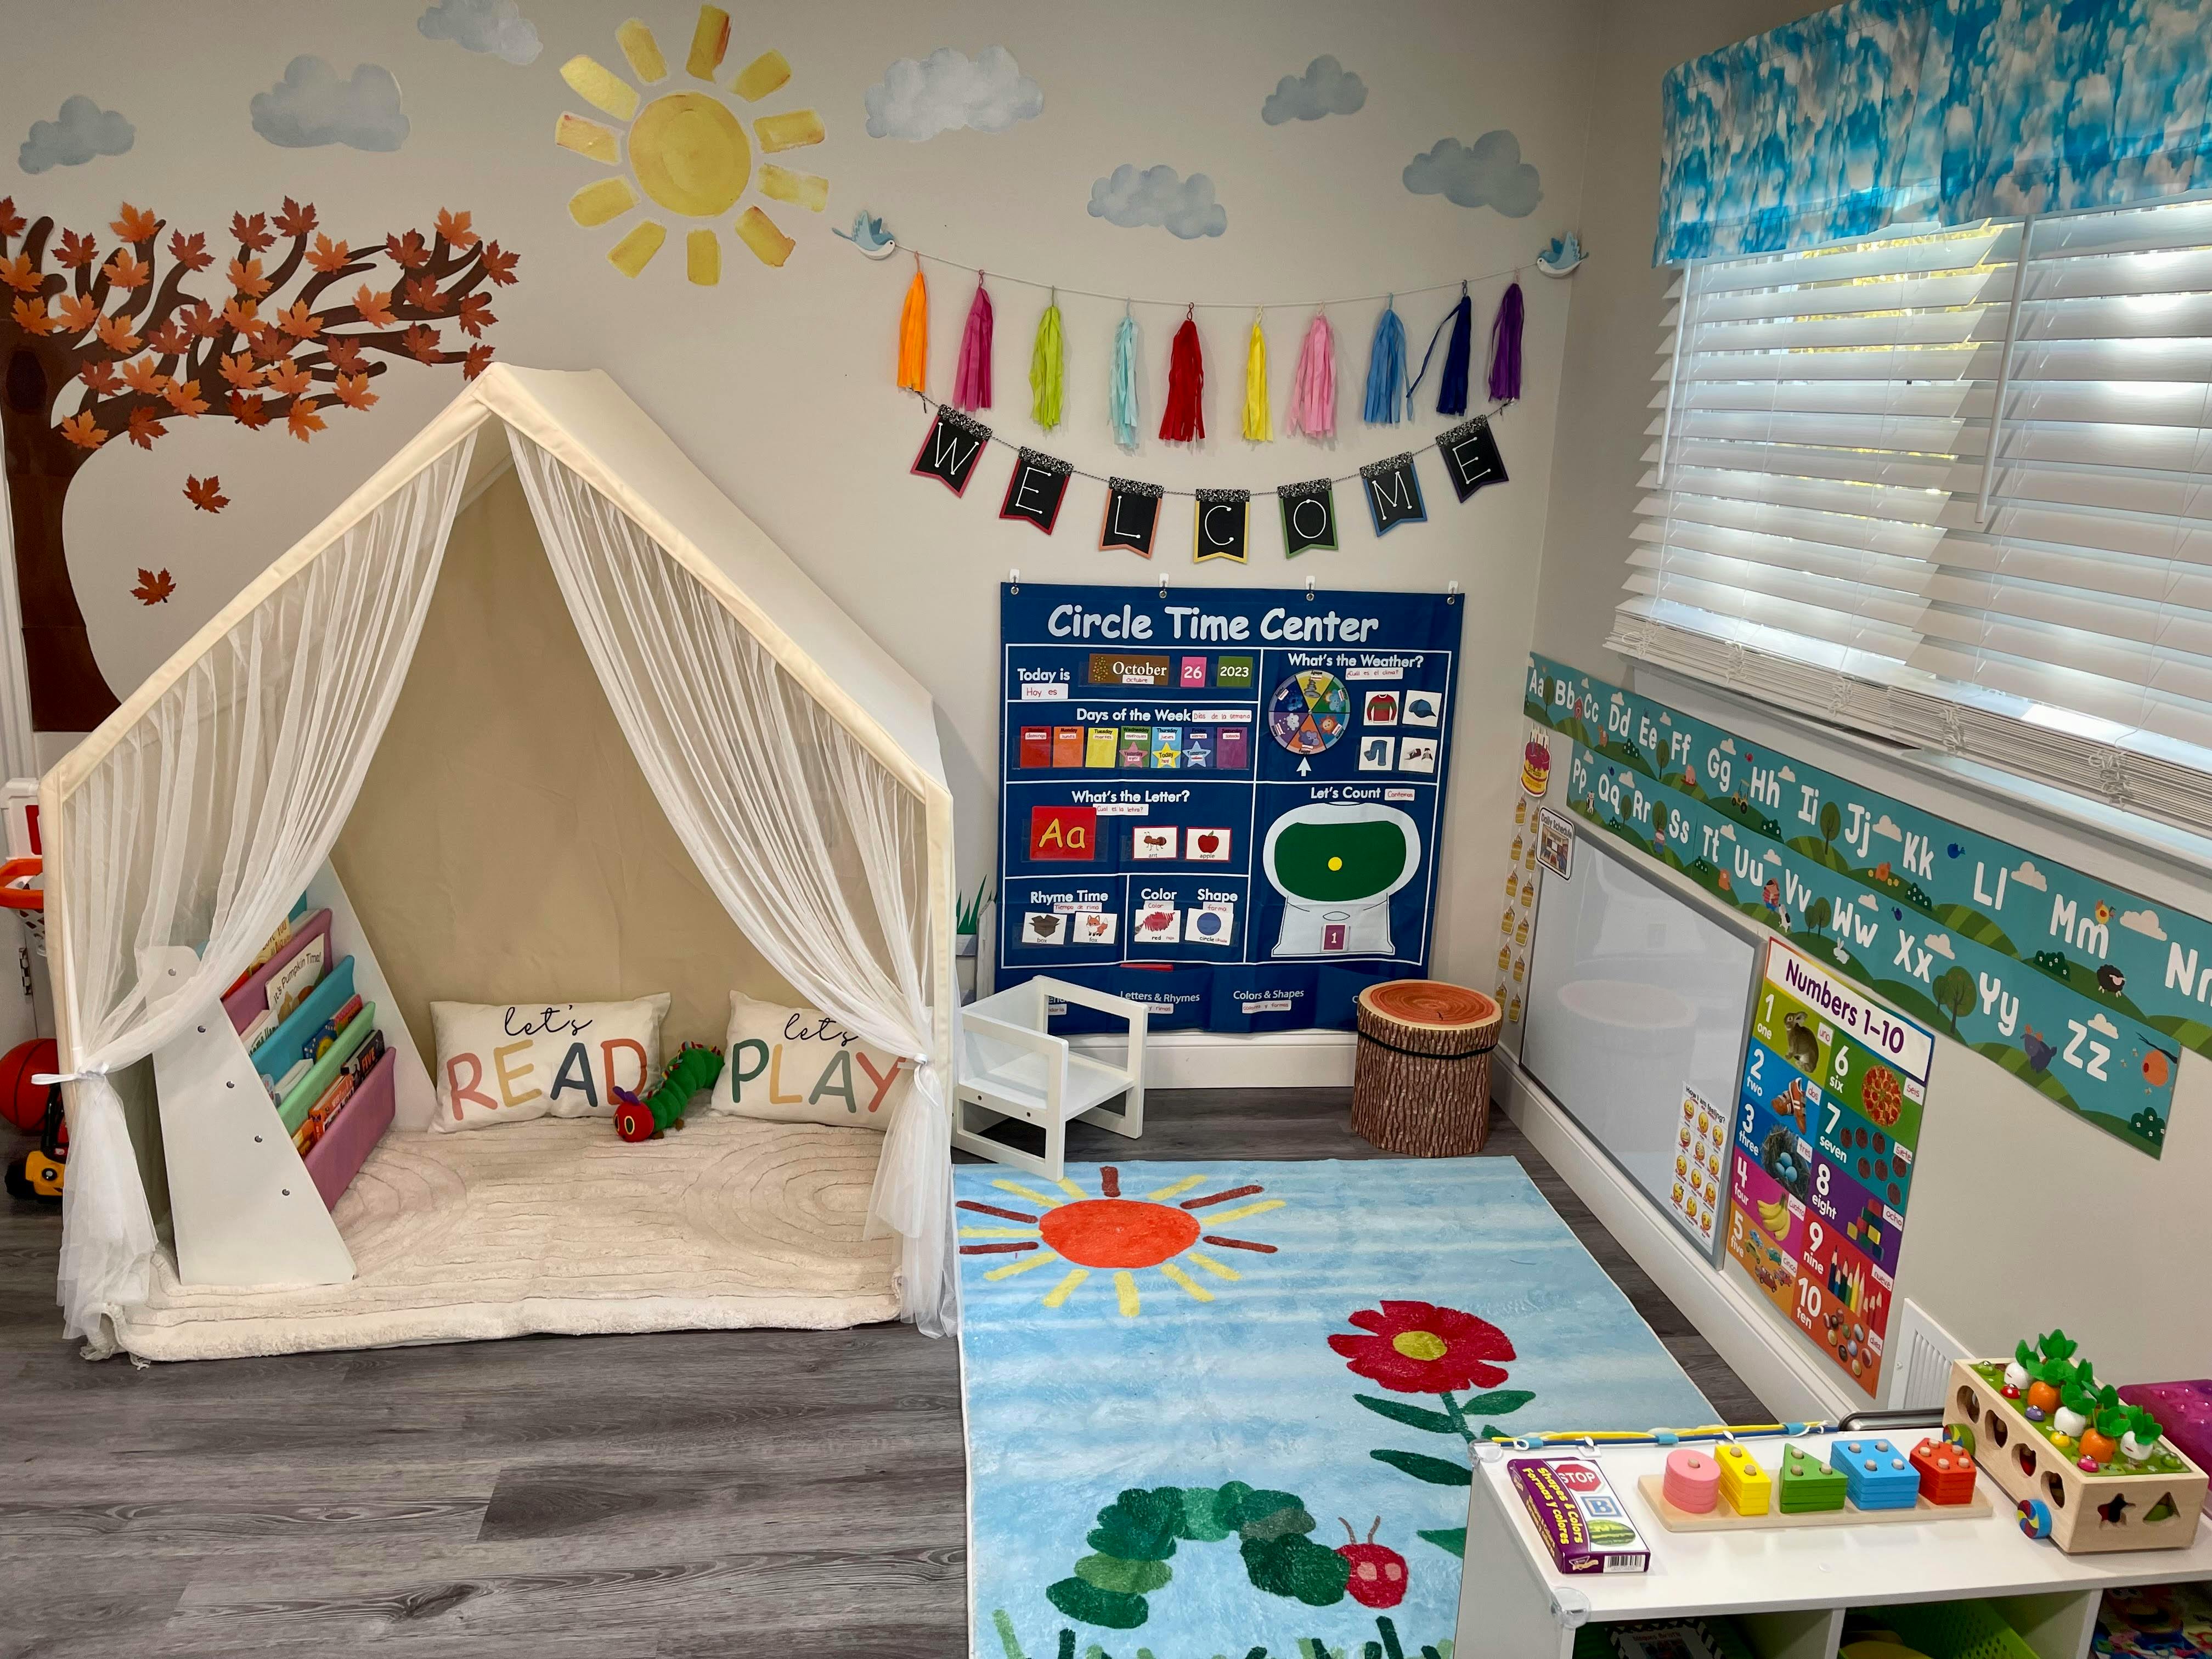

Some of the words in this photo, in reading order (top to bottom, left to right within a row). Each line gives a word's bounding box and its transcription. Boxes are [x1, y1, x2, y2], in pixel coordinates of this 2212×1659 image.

[931, 421, 1492, 546] WELCOME
[1048, 605, 1153, 639] Circle
[1164, 606, 1250, 641] Time
[1260, 607, 1379, 642] Center
[1113, 662, 1167, 676] October
[1220, 666, 1249, 677] 2023
[1288, 653, 1333, 666] What's
[1336, 654, 1356, 667] the
[1361, 654, 1424, 668] Weather?
[1017, 668, 1057, 684] Today
[1060, 669, 1070, 680] is
[1183, 666, 1202, 679] 26
[1026, 687, 1042, 698] Hoy
[1077, 708, 1108, 723] Days
[1113, 708, 1127, 721] of
[1130, 708, 1150, 721] the
[1155, 709, 1190, 722] Week
[1071, 790, 1117, 803] What's
[1120, 790, 1141, 802] the
[1145, 790, 1190, 802] Letter?
[1311, 787, 1339, 798] Let's
[1342, 787, 1381, 798] Count
[1529, 669, 1544, 697] Aa
[1554, 679, 1575, 710] Bb
[1584, 693, 1599, 723] Cc
[1608, 704, 1632, 737] Dd
[1639, 716, 1658, 750] Ee
[1671, 731, 1692, 765] Ff
[1707, 747, 1731, 793] Gg
[1750, 766, 1780, 809] Hh
[1798, 785, 1819, 825] Ii
[1844, 803, 1871, 858] Jj
[1903, 832, 1934, 881] Kk
[1973, 861, 2007, 910] Ll
[2050, 894, 2109, 960] Mm
[1541, 813, 1553, 828] Daily
[1553, 820, 1572, 839] Schedule
[1039, 819, 1085, 848] Aa
[1030, 891, 1073, 905] Rhyme
[1077, 890, 1108, 901] Time
[1141, 888, 1177, 900] Color
[1197, 889, 1238, 904] Shape
[1572, 758, 1587, 794] Pp
[1598, 773, 1621, 815] Qq
[1632, 790, 1651, 823] Rr
[1668, 809, 1690, 844] Ss
[1702, 825, 1719, 862] Tt
[1734, 845, 1763, 887] Uu
[1785, 869, 1812, 912] Vv
[1832, 896, 1879, 948] Ww
[1893, 929, 1934, 984] Xx
[1979, 972, 2019, 1036] Yy
[2063, 1019, 2111, 1081] Zz
[1331, 933, 1337, 944] 1
[274, 986, 282, 1004] It's
[281, 959, 306, 989] Pumpkin
[306, 952, 321, 965] Time!
[1120, 991, 1152, 1001] Letters
[1154, 994, 1161, 1002] &
[1164, 994, 1200, 1004] Rhymes
[1233, 990, 1262, 1000] Colors
[1273, 990, 1304, 999] Shapes
[1785, 959, 1857, 1026] Numbers
[1765, 994, 1775, 1023] 1
[504, 1005, 593, 1037] let's
[785, 1013, 859, 1047] lets
[1757, 1023, 1772, 1040] one
[1819, 1029, 1831, 1043] uno
[362, 1047, 376, 1070] FIVE
[1750, 1048, 1765, 1080] 2
[1835, 1045, 1849, 1076] 6
[445, 1039, 647, 1120] READ
[732, 1039, 906, 1113] PLAY
[1746, 1076, 1763, 1097] two
[1830, 1075, 1843, 1093] six
[1807, 1087, 1819, 1101] dos
[1906, 1083, 1920, 1098] seis
[1686, 1086, 1696, 1098] How
[1700, 1098, 1707, 1107] am
[1707, 1103, 1725, 1124] feeling?
[1742, 1103, 1754, 1133] 3
[1826, 1102, 1841, 1135] 7
[1739, 1130, 1759, 1156] three
[1799, 1142, 1811, 1158] tres
[1819, 1135, 1847, 1163] seven
[1895, 1147, 1912, 1163] siete
[1737, 1156, 1748, 1188] 4
[1816, 1163, 1831, 1196] 8
[1734, 1182, 1749, 1206] four
[1812, 1195, 1837, 1221] eight
[1886, 1210, 1903, 1227] ocho
[1733, 1212, 1743, 1240] 5
[1809, 1222, 1824, 1252] 9
[1730, 1235, 1745, 1259] five
[1782, 1257, 1797, 1274] cinco
[1803, 1250, 1824, 1275] nine
[1874, 1271, 1891, 1289] nueve
[1797, 1277, 1822, 1317] 10
[1796, 1307, 1813, 1330] ten
[1869, 1336, 1882, 1351] diez
[1559, 1472, 1595, 1484] STOP
[1522, 1468, 1554, 1501] Formas
[1553, 1509, 1570, 1544] colores
[1537, 1467, 1568, 1502] Shapes
[1567, 1511, 1583, 1543] Colors
[1590, 1500, 1612, 1513] B
